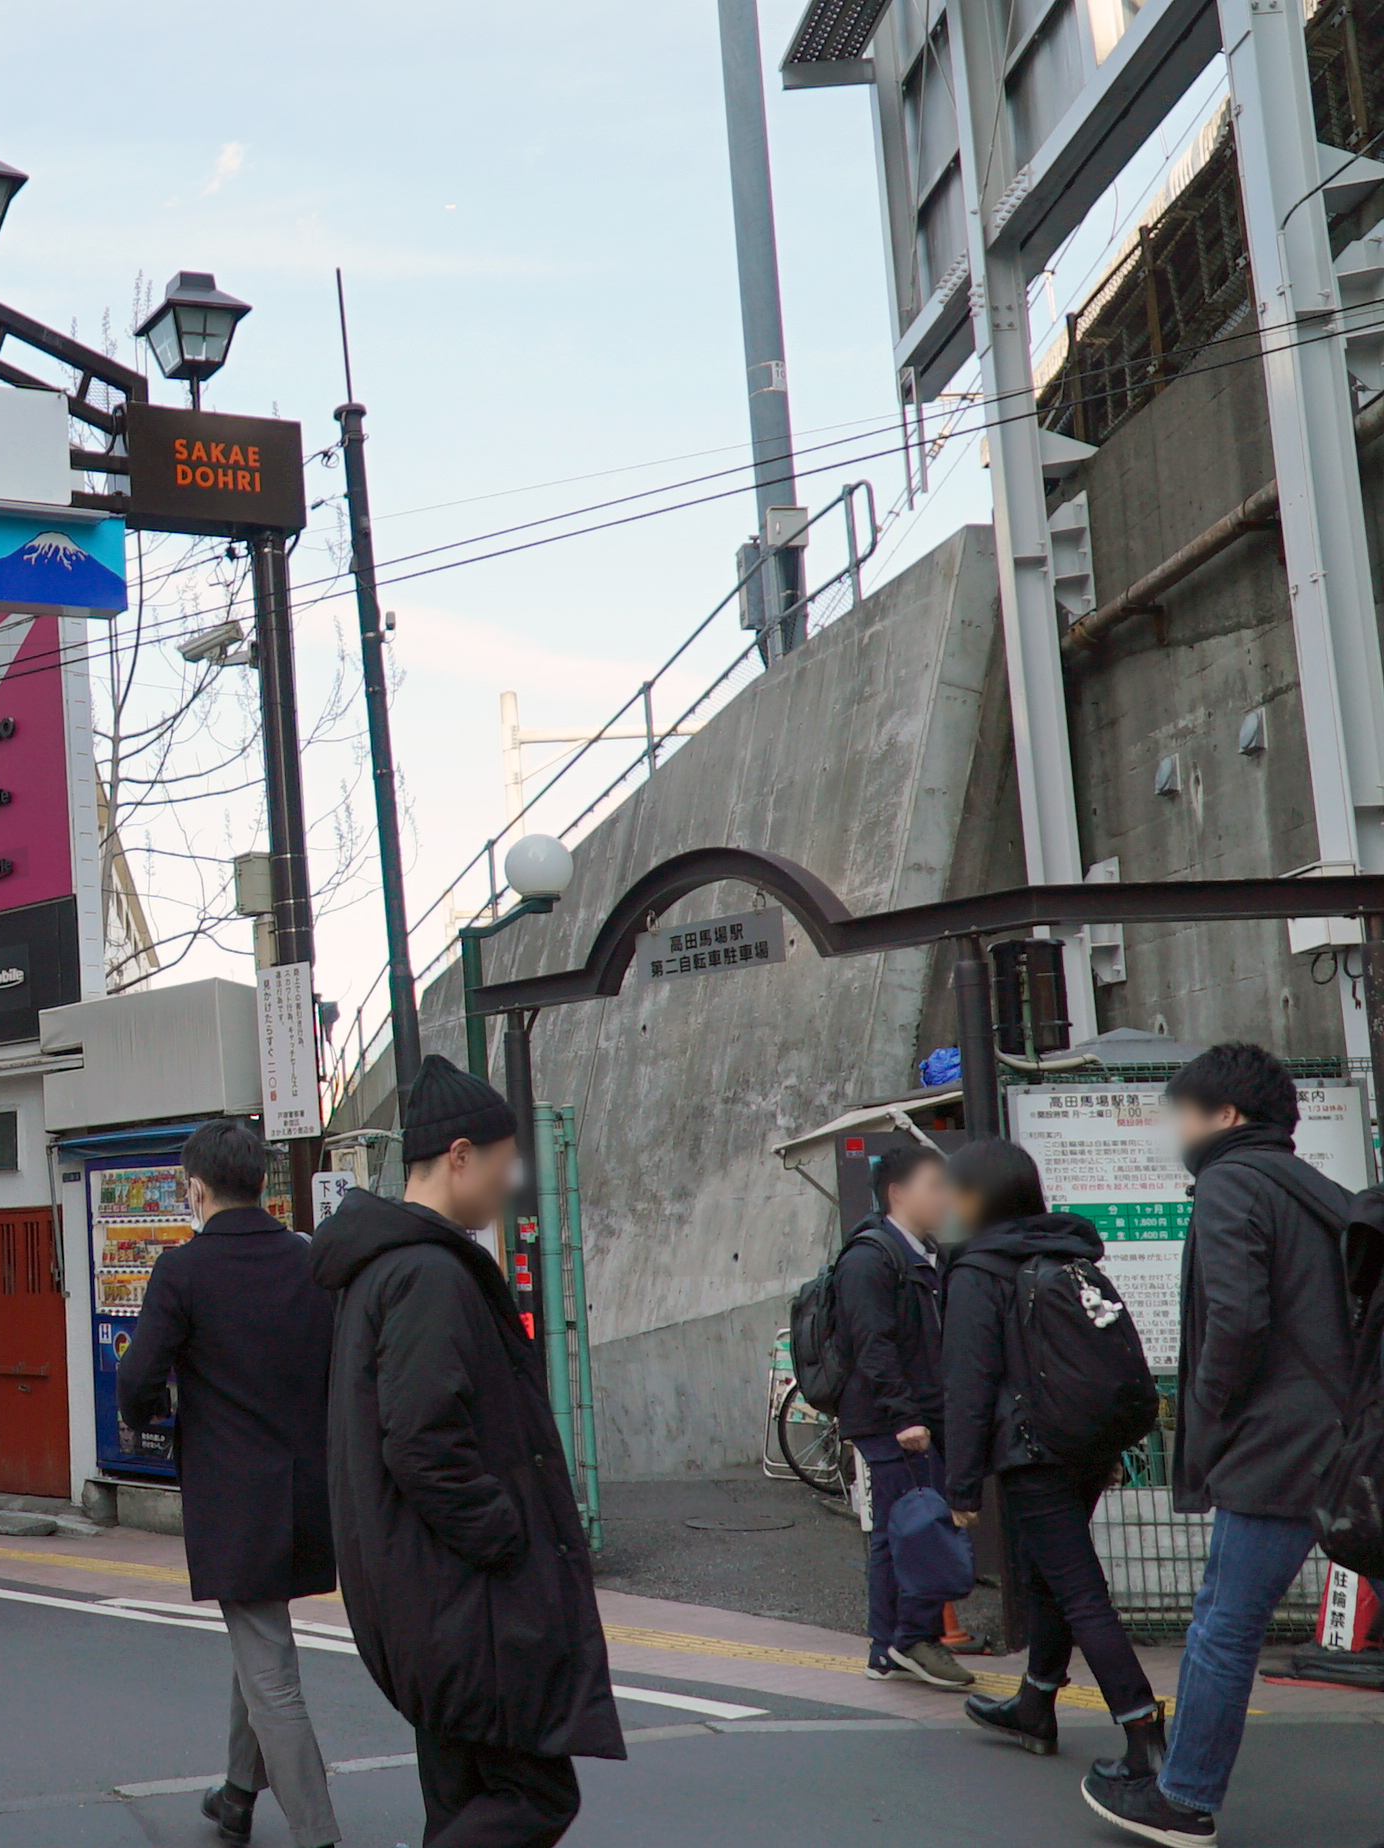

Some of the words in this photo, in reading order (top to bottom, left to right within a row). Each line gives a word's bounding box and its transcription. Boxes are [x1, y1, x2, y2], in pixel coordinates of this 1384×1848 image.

[173, 438, 261, 469] SAKAE
[175, 463, 262, 493] DOHRI
[669, 922, 744, 954] 高田馬場駅
[650, 940, 770, 979] 第二自転車駐車場
